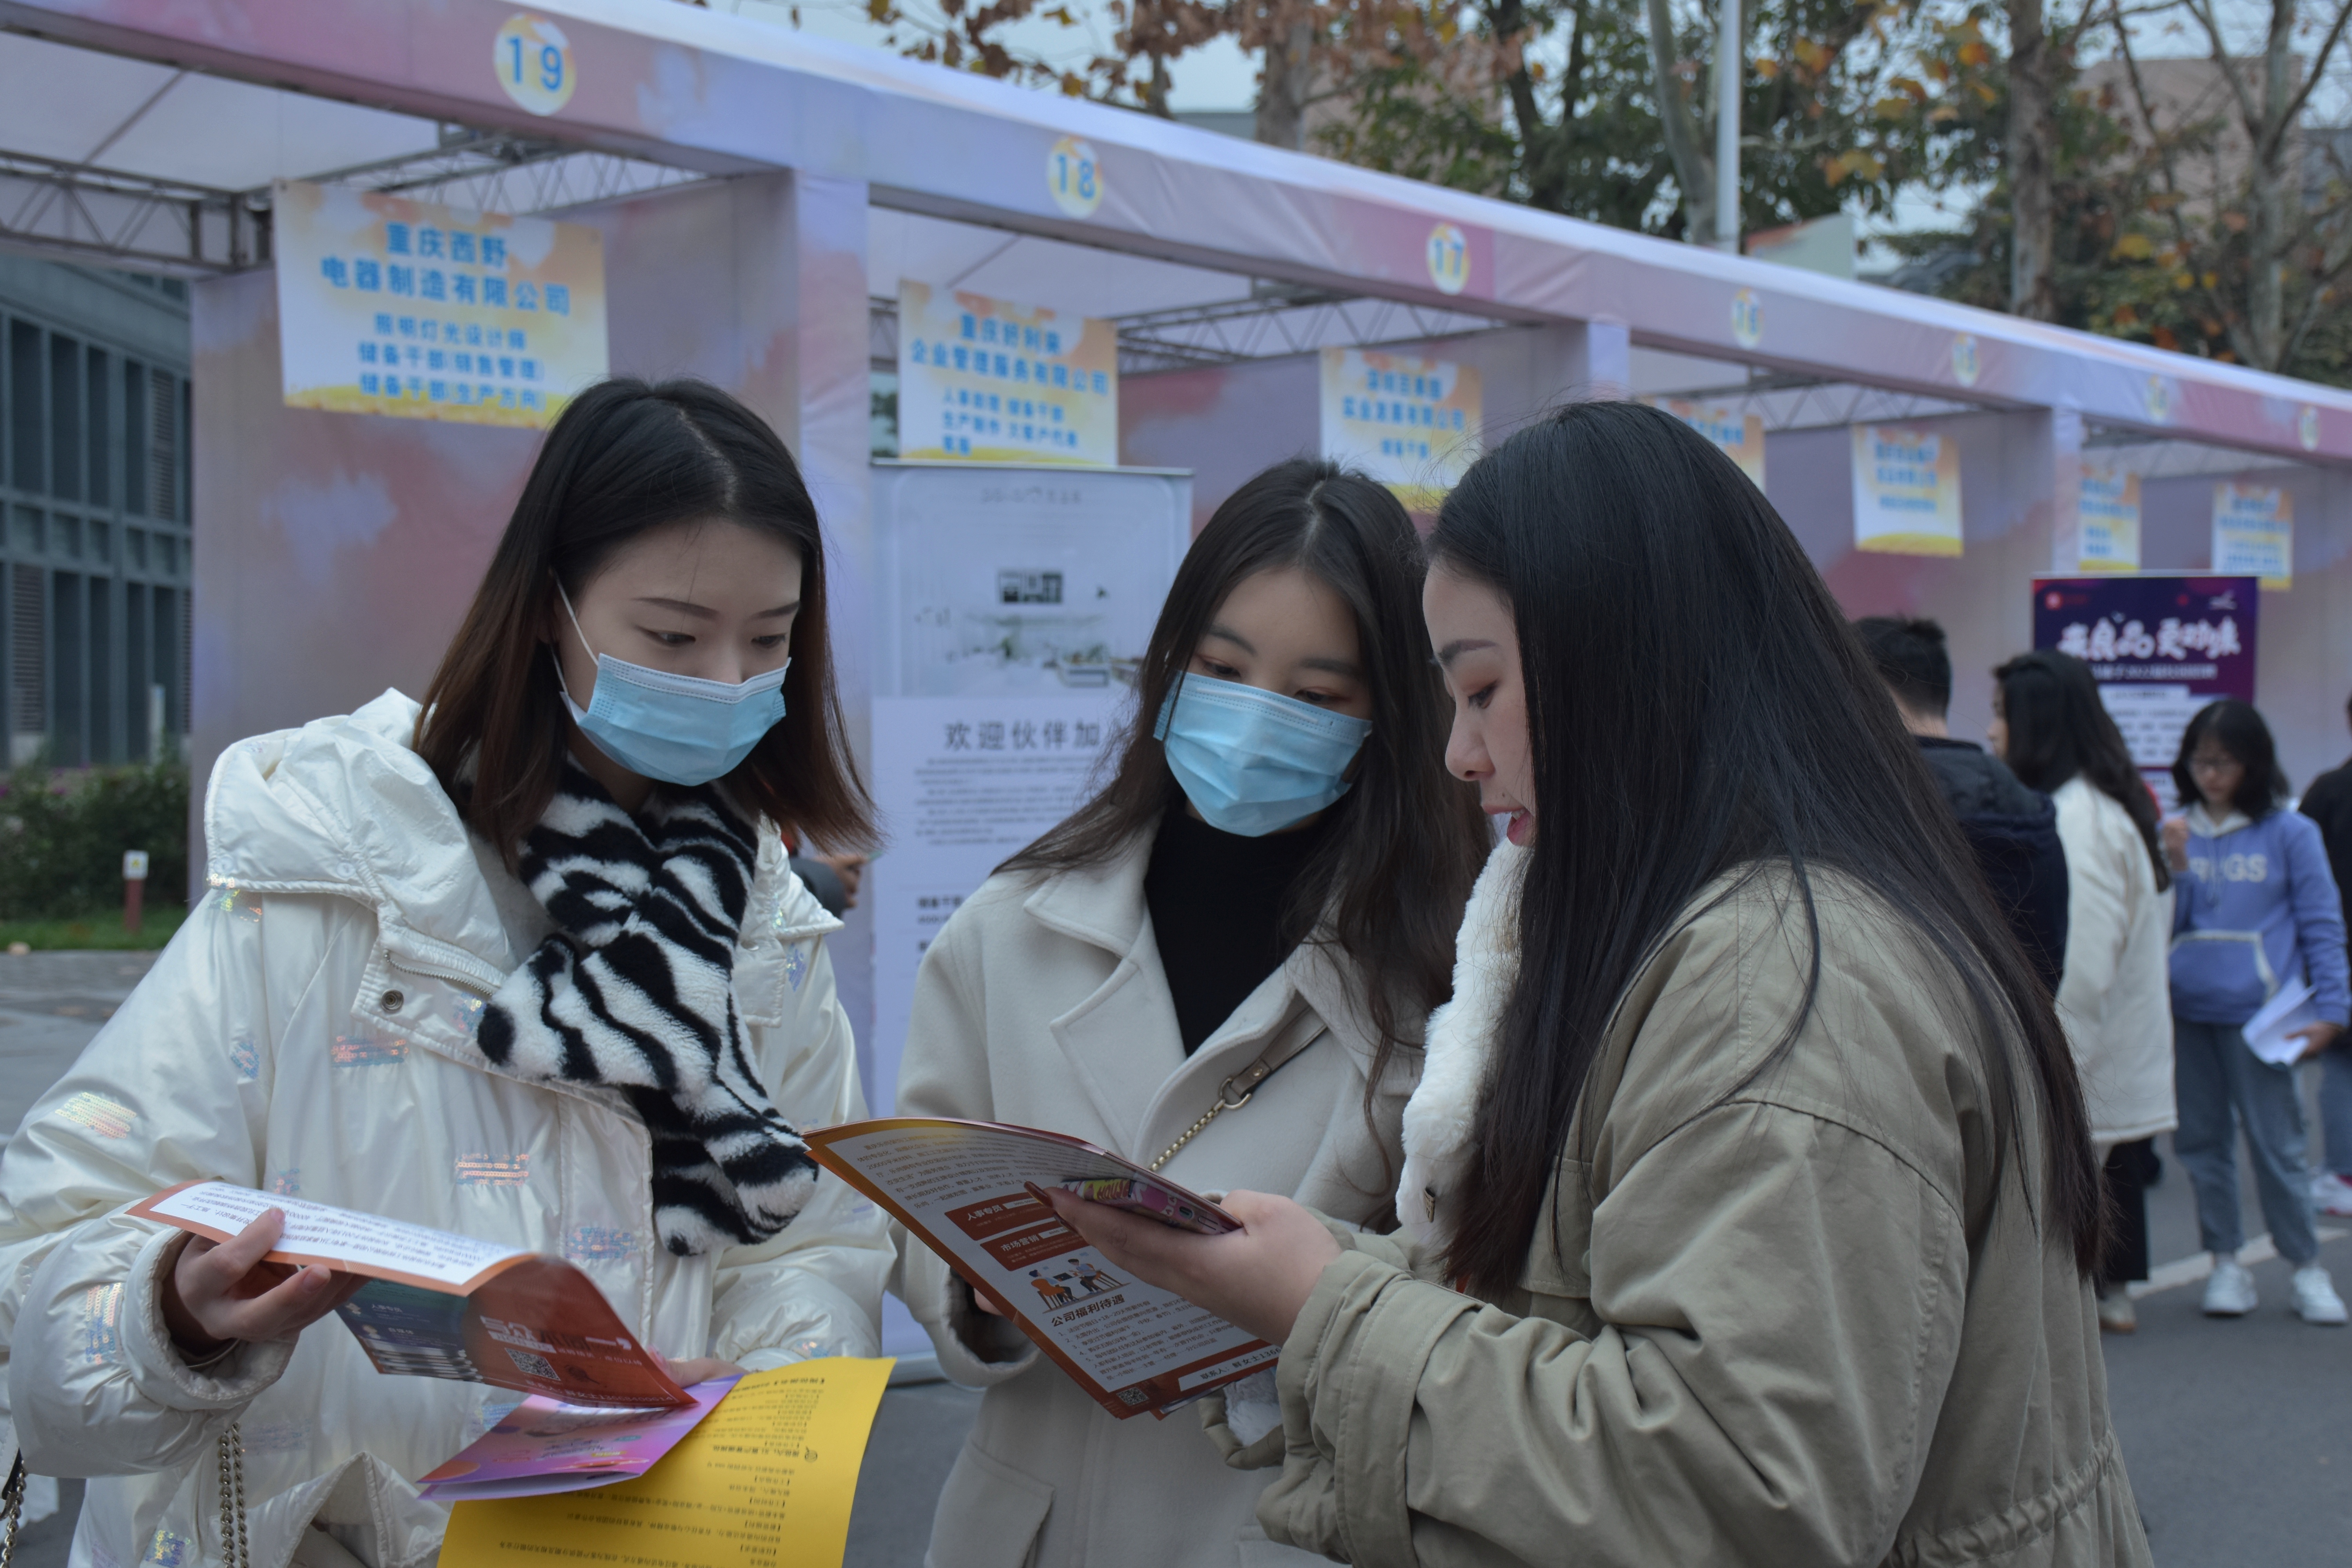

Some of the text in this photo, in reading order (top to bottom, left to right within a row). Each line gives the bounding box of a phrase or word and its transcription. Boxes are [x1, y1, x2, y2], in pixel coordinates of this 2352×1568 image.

[506, 36, 563, 93] 19
[1055, 152, 1096, 199] 18
[386, 221, 508, 269] 重庆西野
[1433, 238, 1465, 278] 17
[320, 255, 571, 316] 电器制造有限公司
[944, 720, 1101, 751] 欢迎伙伴加
[968, 1205, 1003, 1221] 人事专员
[1001, 1234, 1040, 1252] 市场营销
[1051, 1294, 1125, 1327] 公司福利待遇
